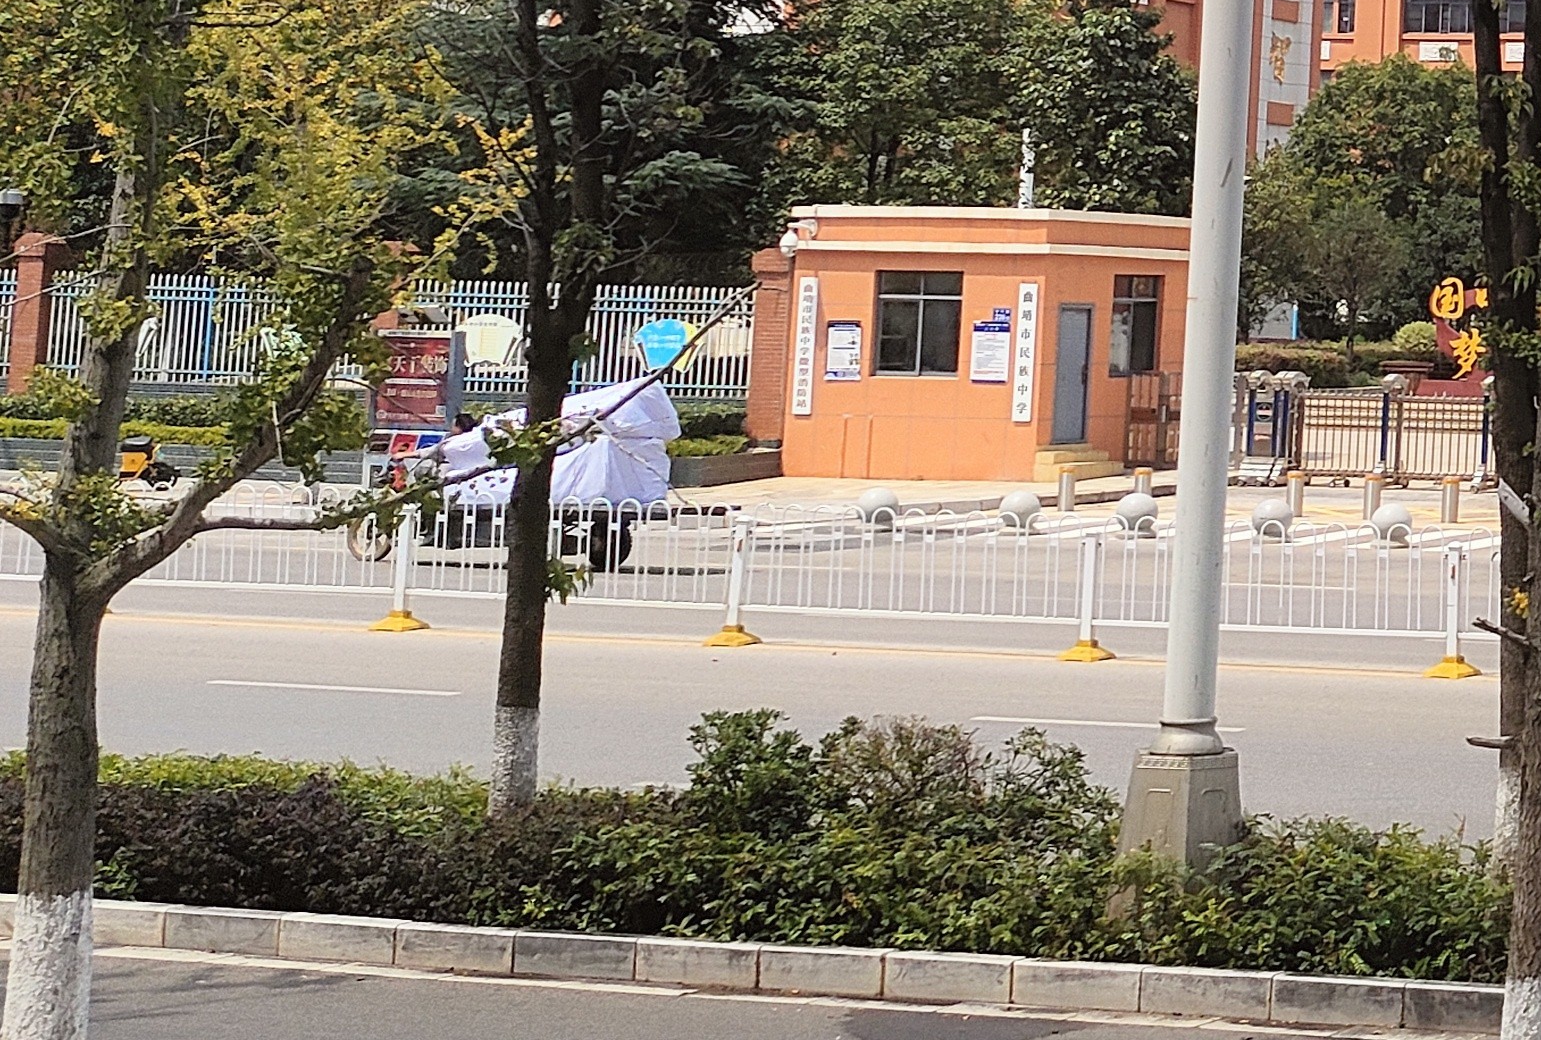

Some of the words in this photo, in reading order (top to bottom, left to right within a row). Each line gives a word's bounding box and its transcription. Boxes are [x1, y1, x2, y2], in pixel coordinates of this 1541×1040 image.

[1016, 291, 1034, 414] 曲靖市民族中学
